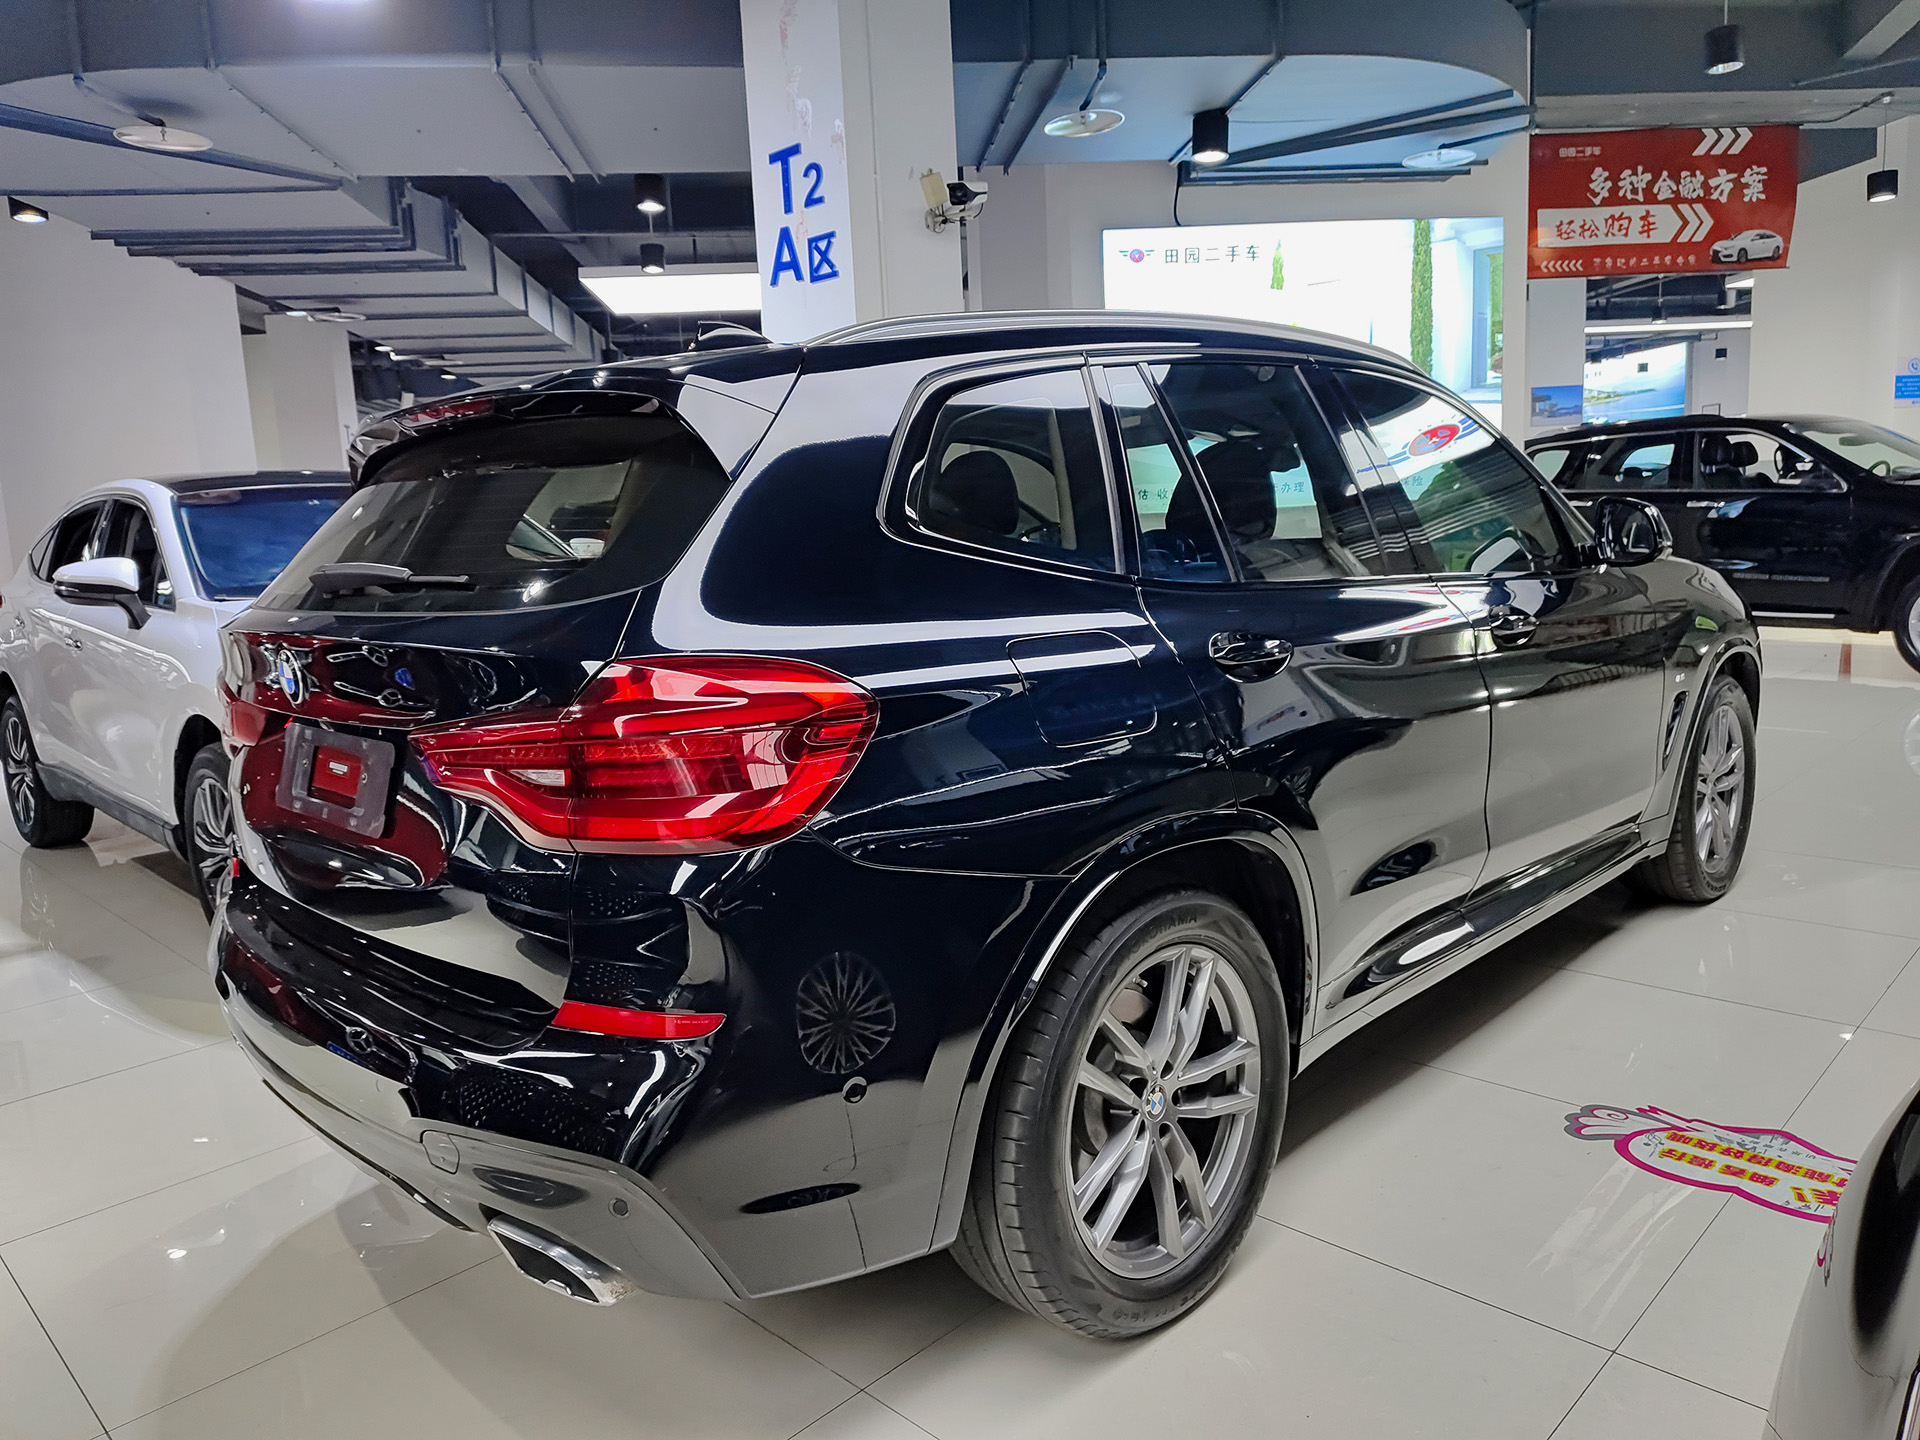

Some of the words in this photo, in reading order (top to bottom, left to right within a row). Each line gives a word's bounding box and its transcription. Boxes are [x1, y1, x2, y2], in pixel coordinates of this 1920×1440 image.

[769, 142, 825, 214] T2
[1587, 165, 1768, 205] 多种金融方案
[1555, 210, 1659, 240] 轻松购车
[770, 225, 840, 288] A区
[1164, 245, 1260, 264] 田园二手车
[1274, 482, 1305, 494] 办理
